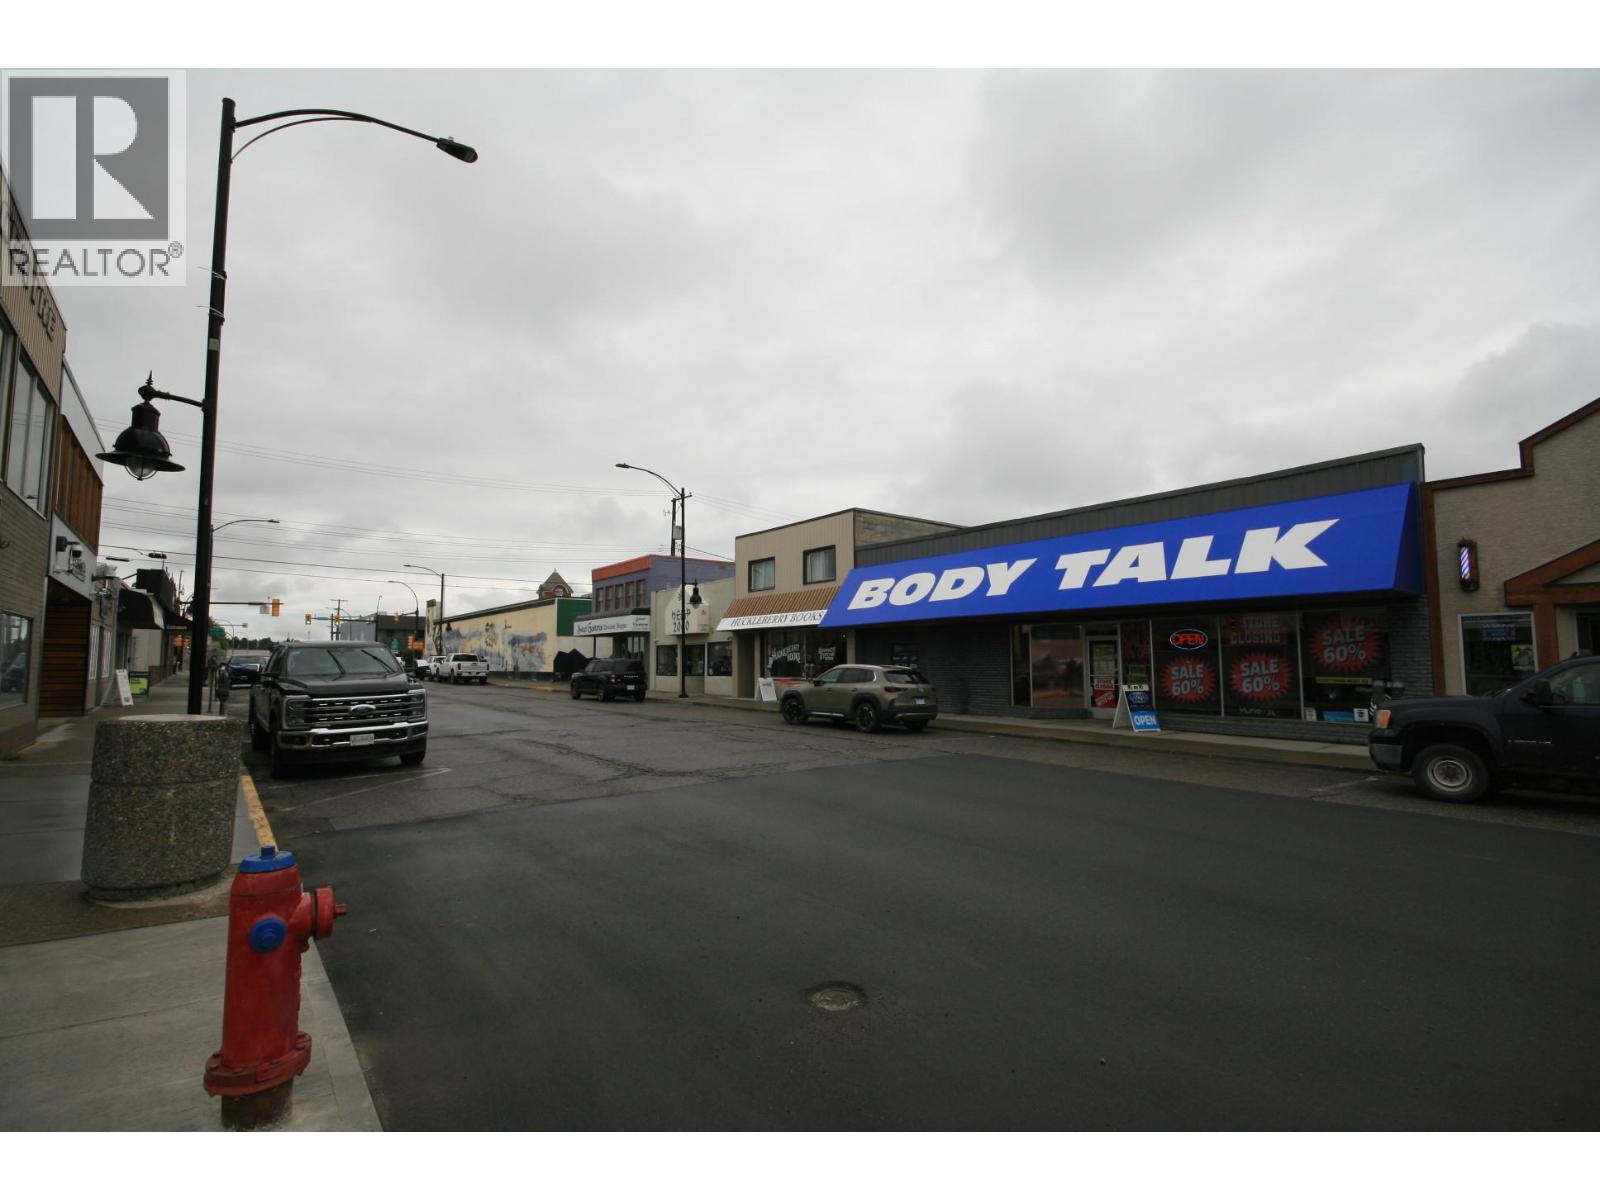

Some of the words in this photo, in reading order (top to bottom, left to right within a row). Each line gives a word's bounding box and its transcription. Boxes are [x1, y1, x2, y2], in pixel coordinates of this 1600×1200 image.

[846, 557, 1038, 611] BODY
[1054, 518, 1340, 590] TALK
[730, 614, 789, 627] HUCKLEBERRY
[790, 611, 823, 622] BOOKS
[1173, 632, 1205, 646] OPEN
[1322, 624, 1366, 646] SALE
[1322, 643, 1367, 664] 60%
[1170, 664, 1204, 681] SALE
[1240, 658, 1279, 677] SALE
[1171, 678, 1206, 696] 60%
[1241, 675, 1280, 693] 60%
[1133, 714, 1157, 726] OPEN
